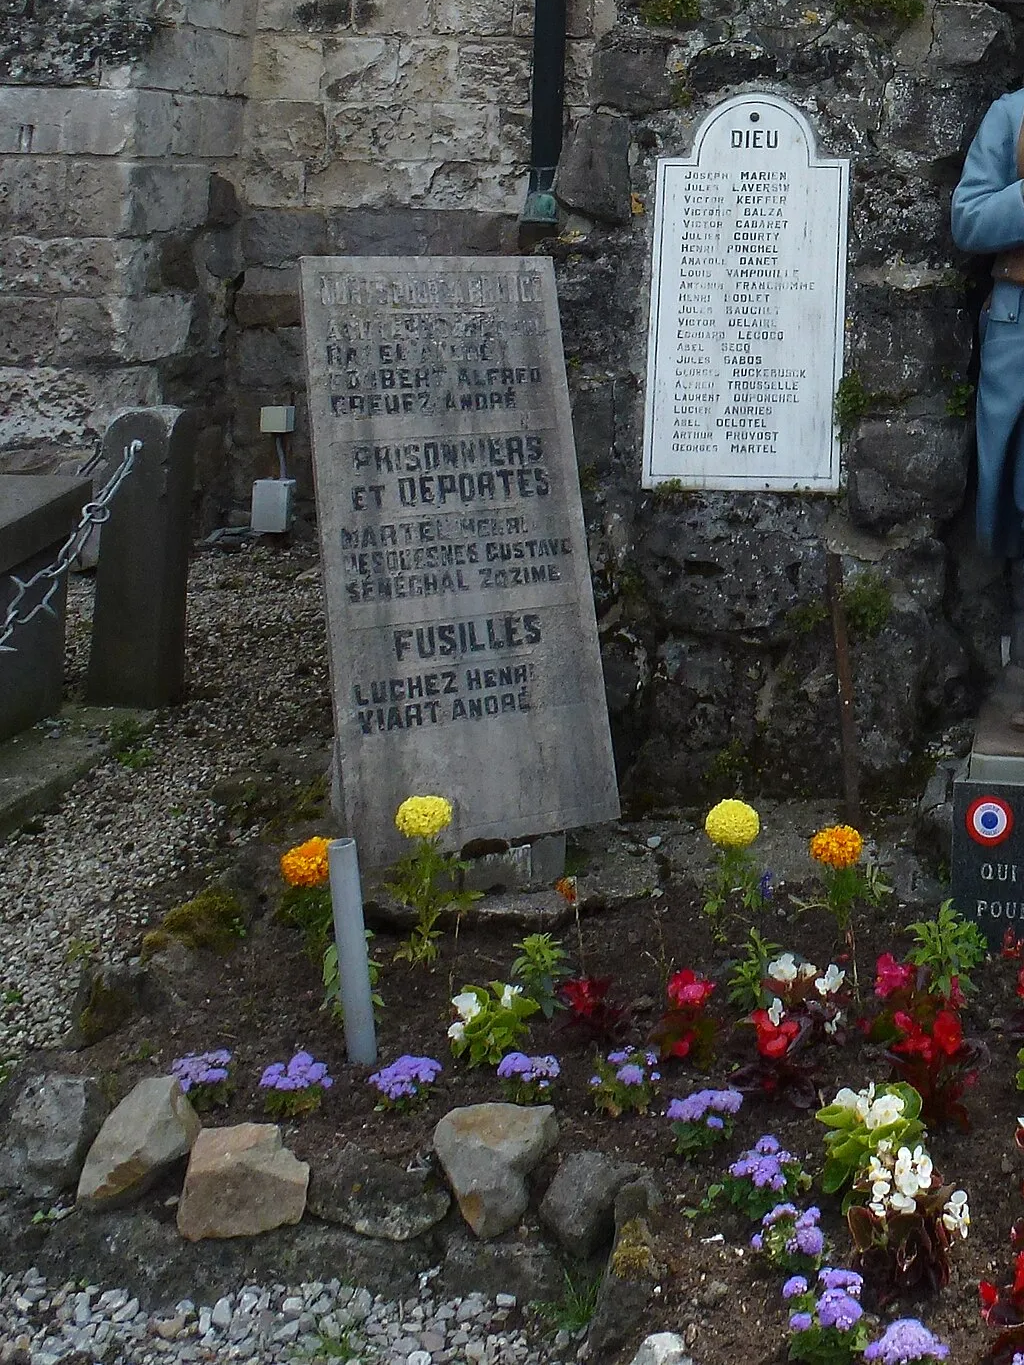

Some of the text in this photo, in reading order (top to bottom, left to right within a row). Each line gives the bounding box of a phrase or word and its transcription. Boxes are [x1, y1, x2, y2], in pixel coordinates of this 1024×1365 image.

[731, 130, 779, 149] DIEU
[740, 171, 788, 180] MARIEN
[744, 207, 783, 216] BALZA
[683, 220, 788, 229] VICTOR CABARET
[734, 232, 780, 241] COURTY
[727, 244, 778, 254] PONCHEL
[352, 436, 543, 473] PRISONNIERS
[730, 444, 777, 454] MARTEL
[351, 484, 385, 511] ET
[353, 671, 459, 706] LUCHEZ
[358, 699, 440, 734] VIART
[980, 862, 1018, 883] QUI
